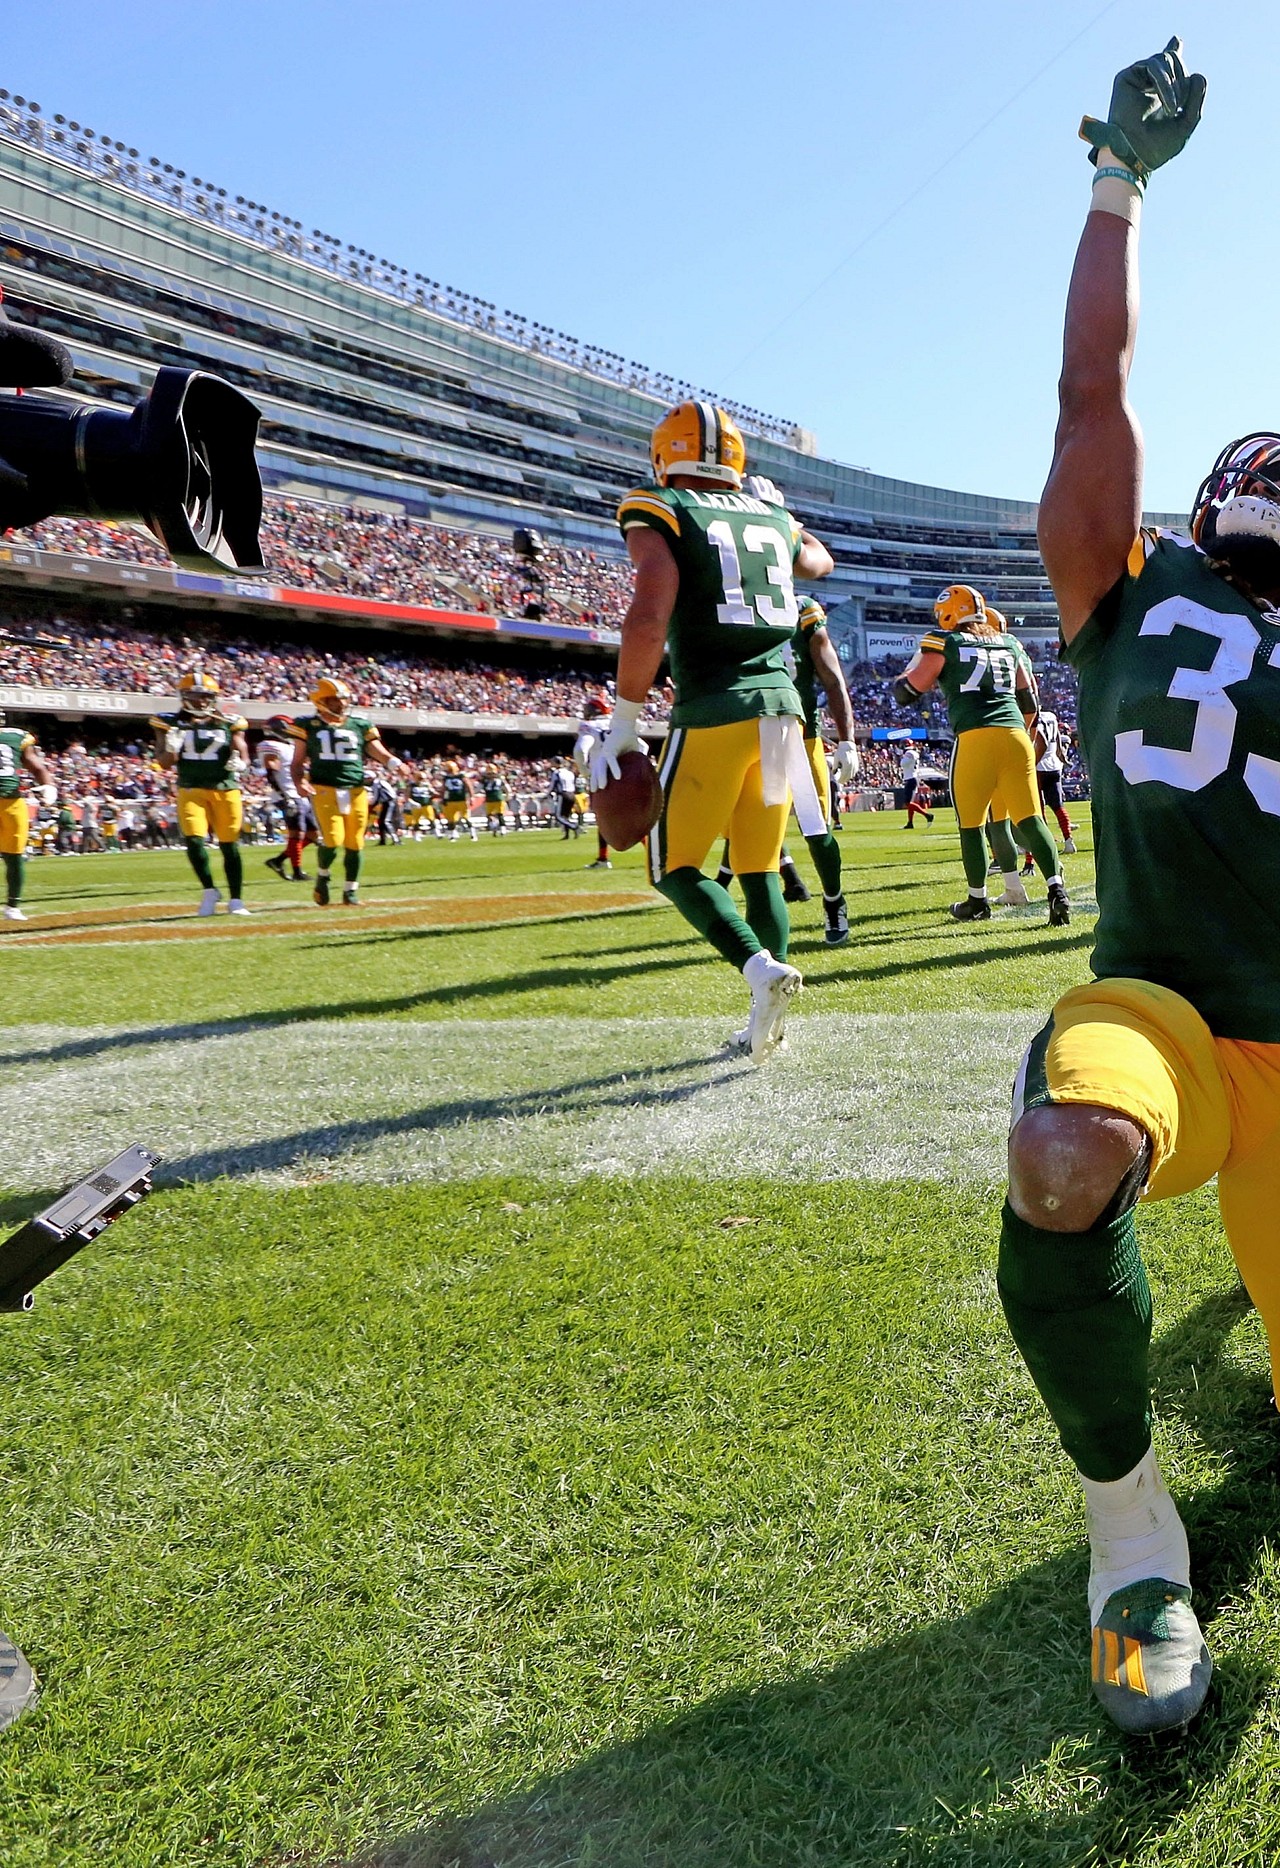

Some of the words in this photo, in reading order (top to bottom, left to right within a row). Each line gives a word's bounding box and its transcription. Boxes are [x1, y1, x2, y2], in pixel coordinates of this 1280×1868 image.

[685, 488, 773, 516] LAZARD
[706, 519, 799, 627] 13
[868, 637, 903, 648] proven
[906, 638, 915, 647] IT
[958, 646, 1017, 694] 70
[78, 695, 129, 710] FIELD
[181, 728, 227, 761] 17
[315, 729, 359, 761] 12
